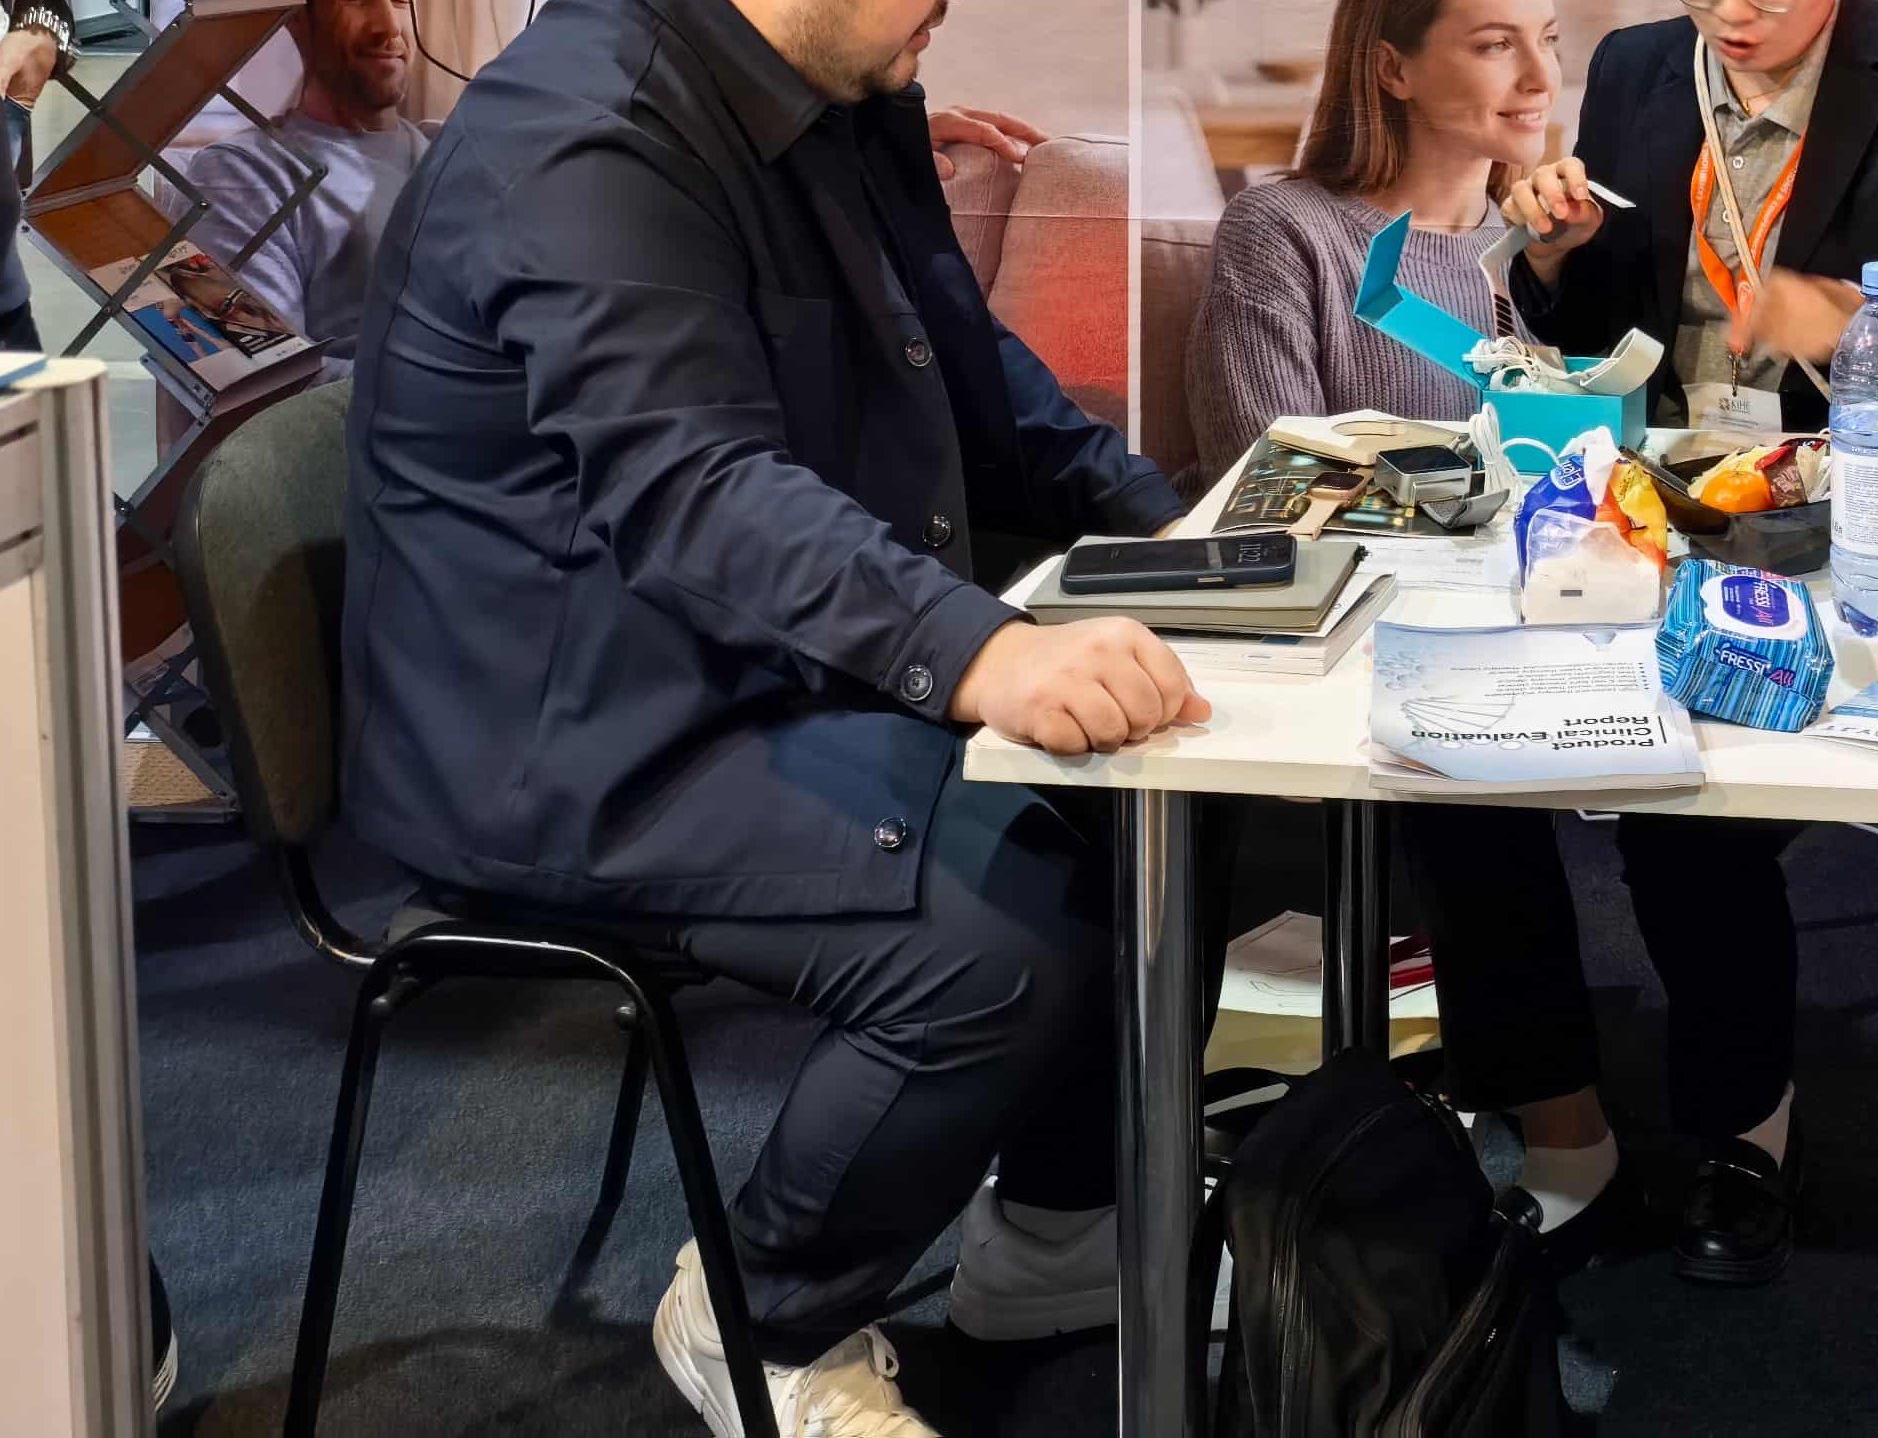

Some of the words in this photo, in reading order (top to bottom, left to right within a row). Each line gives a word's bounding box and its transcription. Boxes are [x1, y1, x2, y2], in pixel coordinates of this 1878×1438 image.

[1563, 715, 1650, 728] Report
[1411, 730, 1548, 742] Evaluation
[1557, 727, 1652, 739] Clinical
[1551, 739, 1655, 751] Product
